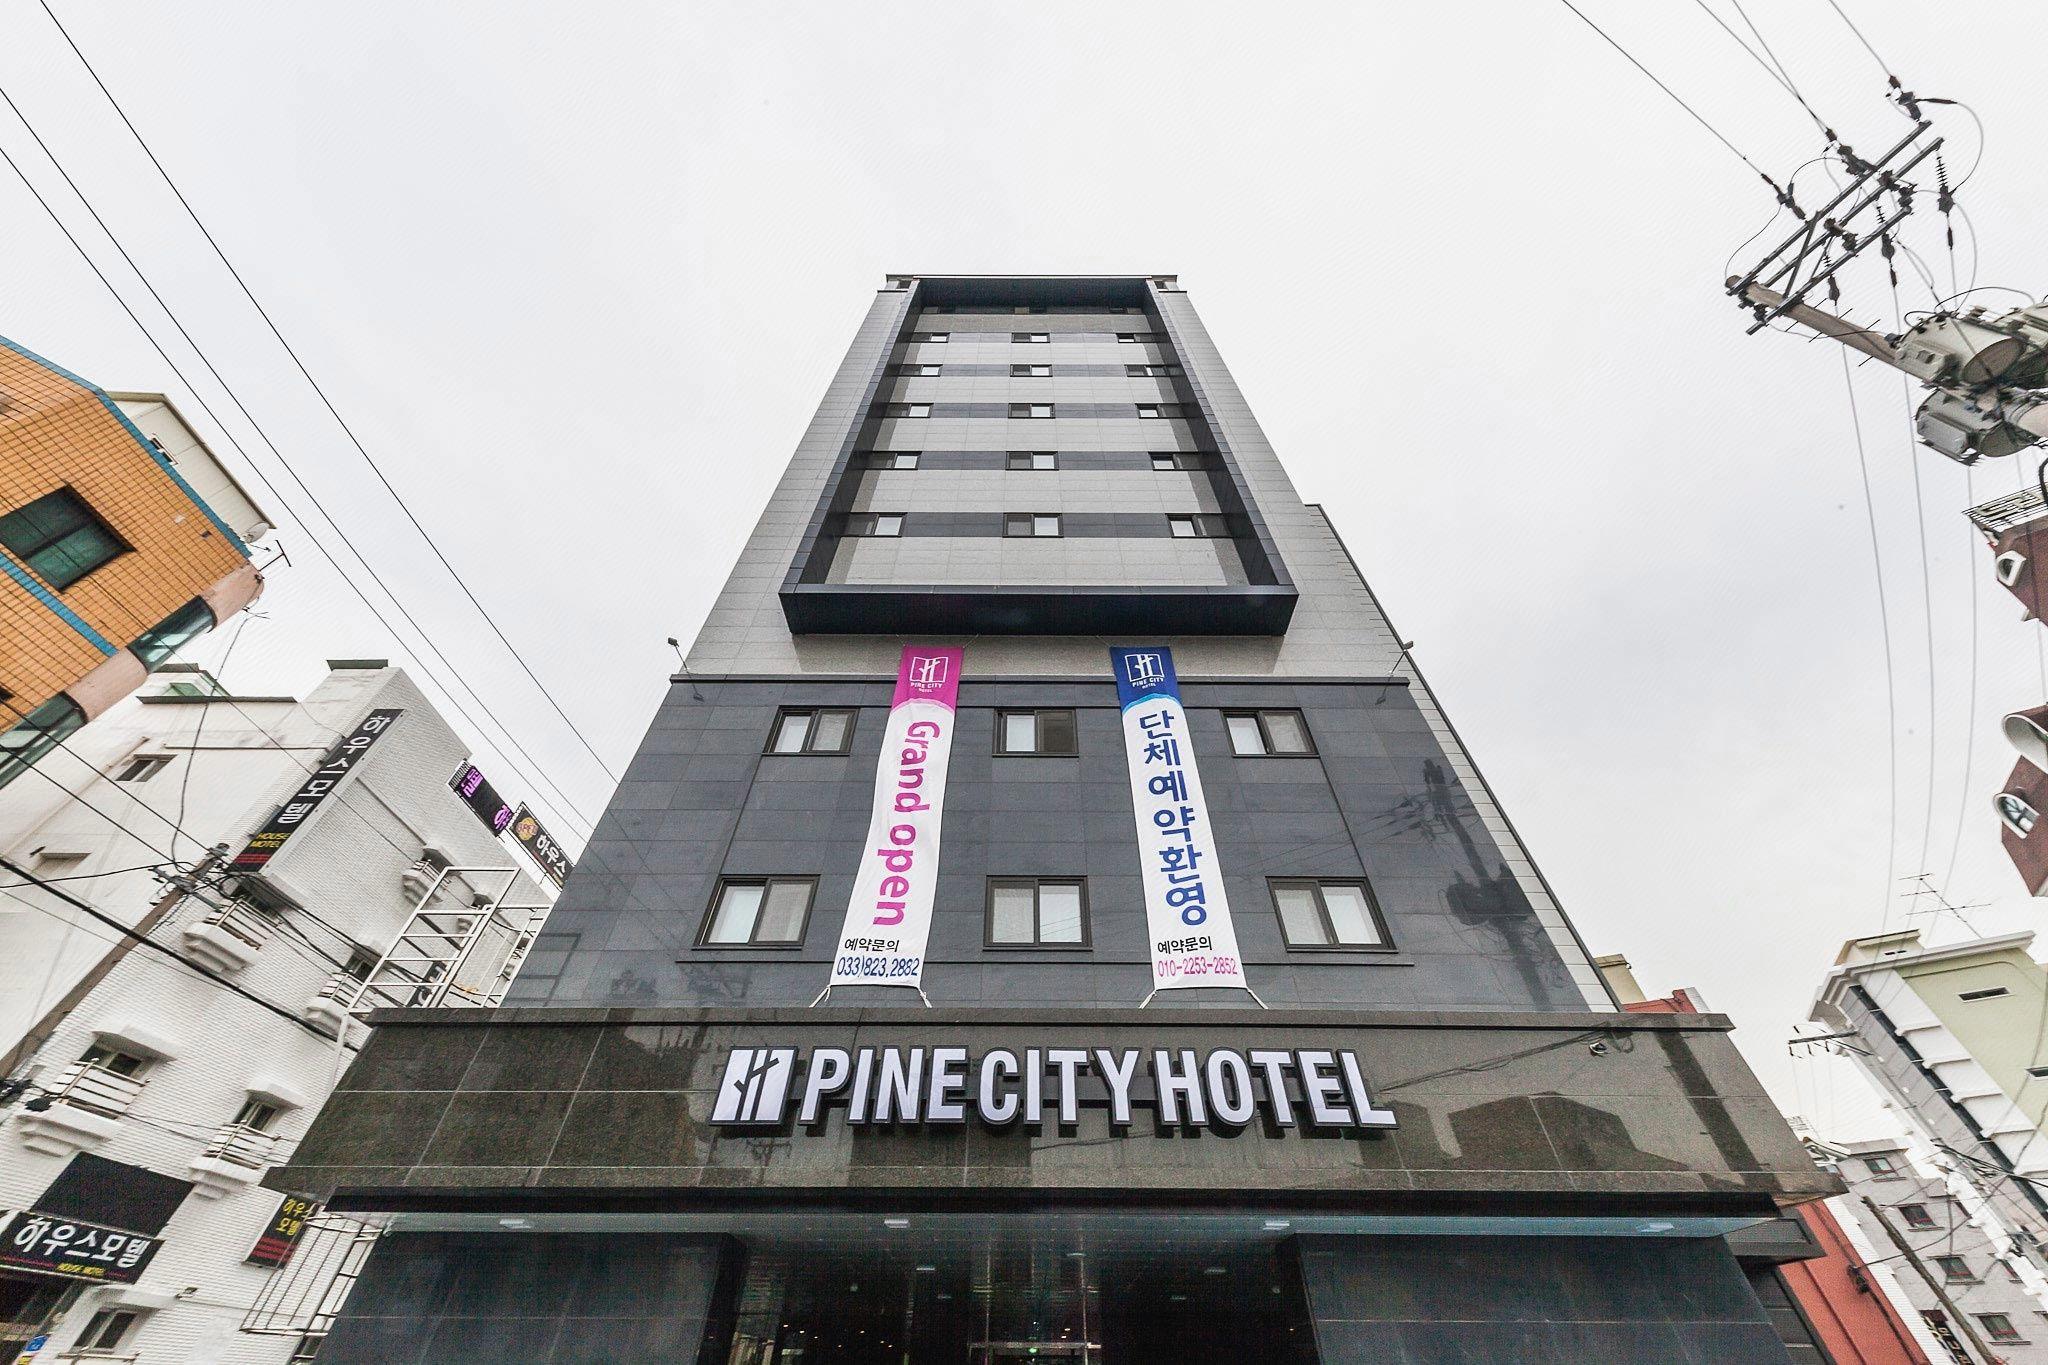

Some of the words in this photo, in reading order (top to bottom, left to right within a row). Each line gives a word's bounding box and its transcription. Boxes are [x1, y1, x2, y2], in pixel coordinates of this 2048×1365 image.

[277, 715, 391, 825] 하우스모텔
[895, 721, 940, 812] Grand
[256, 832, 291, 840] HOUSE
[1139, 710, 1207, 926] 단체예약환영
[250, 840, 283, 848] MOTEL
[536, 834, 568, 878] 하우스
[872, 825, 917, 926] open
[844, 937, 900, 953] 예약문의
[1157, 936, 1213, 955] 예약문의
[1158, 956, 1238, 977] 010-2253-2852
[800, 1047, 968, 1124] PINE
[980, 1047, 1139, 1124] CITY
[1154, 1048, 1397, 1127] HOTEL
[14, 1217, 151, 1268] 하우스모텔
